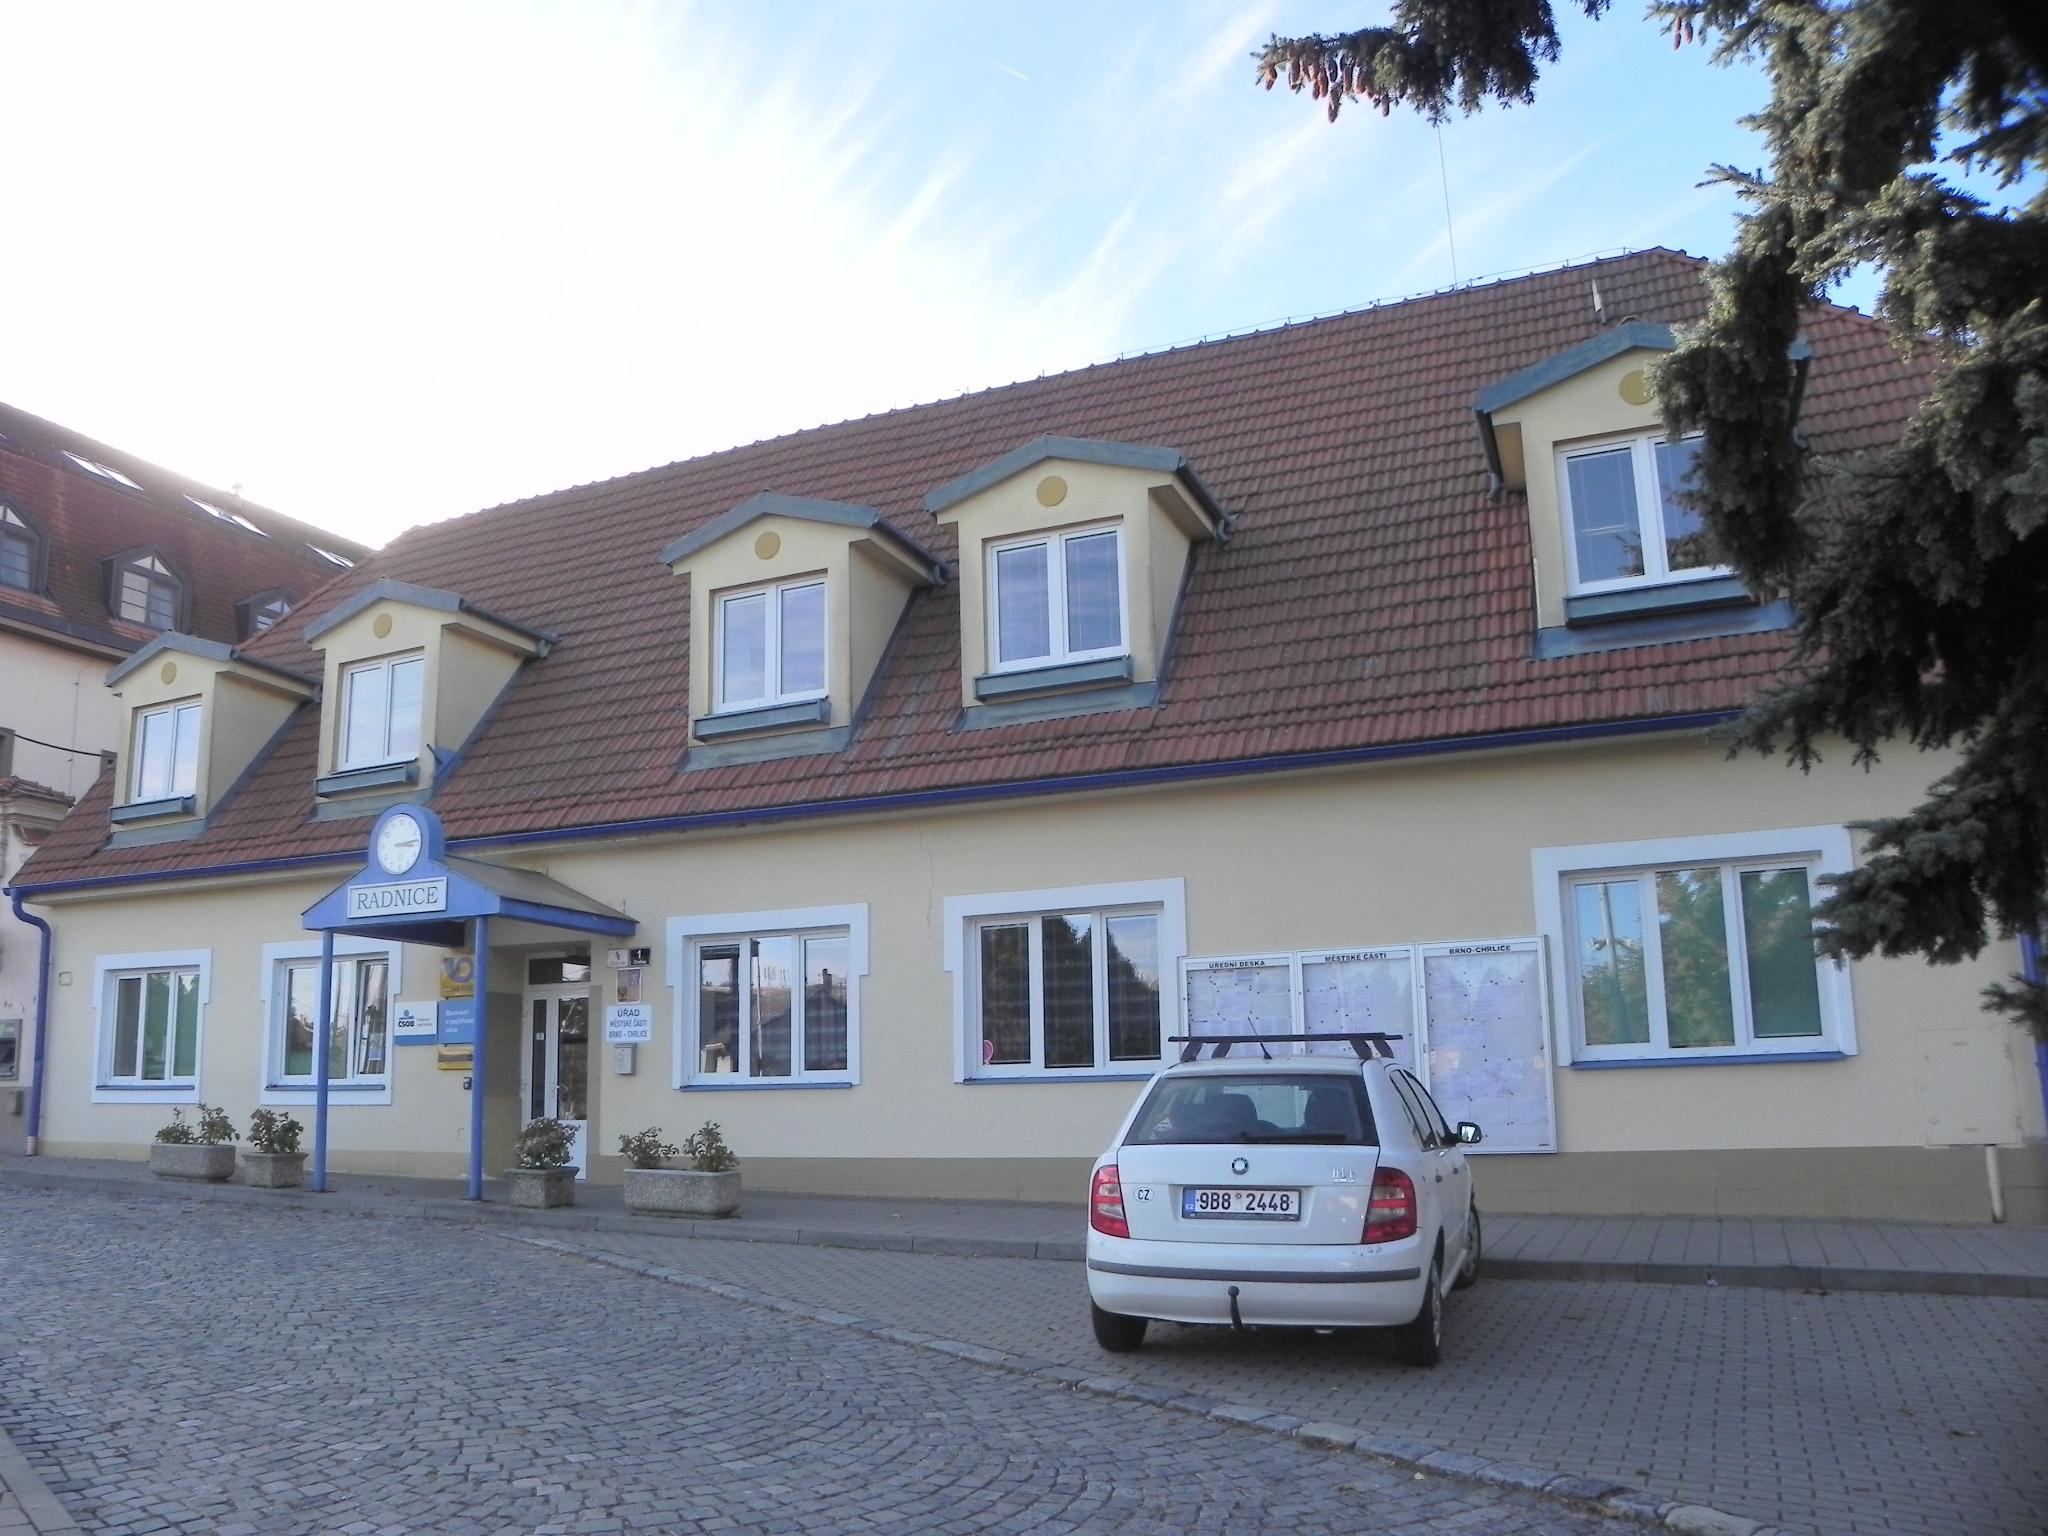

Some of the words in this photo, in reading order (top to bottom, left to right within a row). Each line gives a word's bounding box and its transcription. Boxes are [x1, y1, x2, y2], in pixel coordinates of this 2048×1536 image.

[357, 886, 438, 909] RADNICE
[617, 1008, 640, 1018] ÚŘAD
[1137, 1189, 1150, 1201] CZ
[1199, 1191, 1231, 1210] 9B8
[1245, 1193, 1290, 1211] 2448
